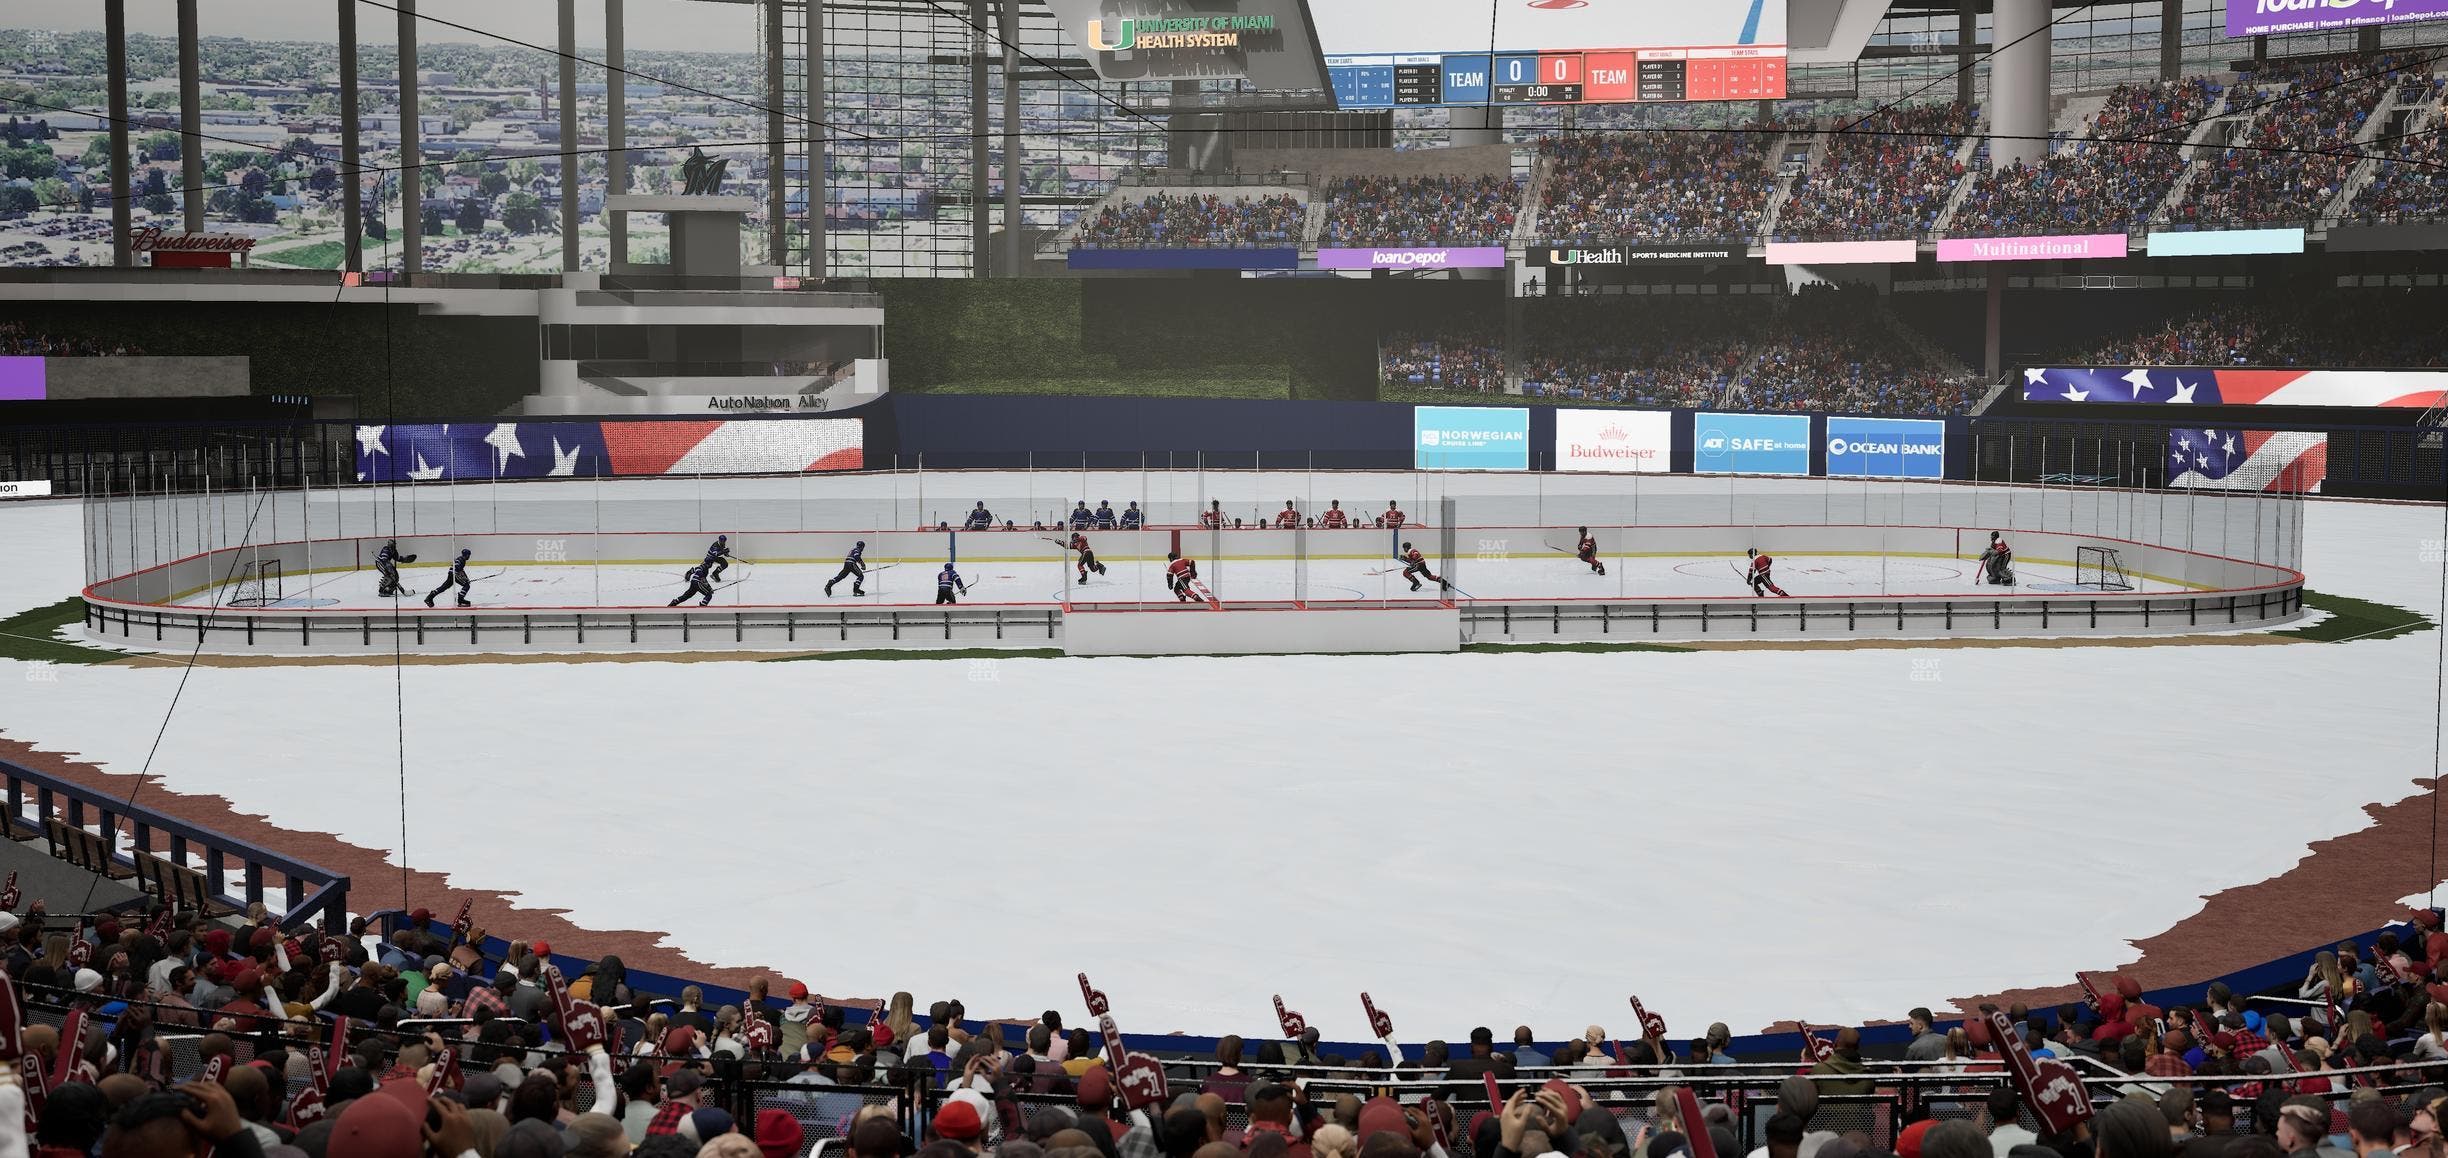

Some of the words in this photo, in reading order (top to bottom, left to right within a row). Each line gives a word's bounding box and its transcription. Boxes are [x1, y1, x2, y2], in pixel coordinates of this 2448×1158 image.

[1135, 17, 1208, 32] UNIVERSITY
[1211, 17, 1230, 30] OF
[1231, 15, 1275, 30] MIAMI
[2246, 25, 2269, 34] HOME
[2270, 21, 2314, 32] PURCHASE
[2320, 20, 2343, 28] Home
[2345, 17, 2385, 26] Refinance
[1136, 34, 1183, 49] HEALTH
[1187, 33, 1237, 47] SYSTEM
[1509, 60, 1521, 82] 0
[1554, 59, 1566, 80] 0
[1590, 69, 1626, 85] TEAM
[1448, 72, 1483, 87] TEAM
[1526, 86, 1548, 97] 0:00
[129, 227, 257, 252] Budweiser
[1973, 239, 2089, 256] Multinational
[1372, 250, 1447, 266] loanDepot
[1631, 252, 1657, 260] SPORTS
[1659, 251, 1691, 259] MEDICINE
[708, 396, 790, 409] AutoNation
[798, 395, 829, 411] Alley
[1441, 430, 1523, 441] NORWEGIAN
[1703, 438, 1725, 449] ADT
[1570, 444, 1656, 459] Budweiser
[1731, 438, 1774, 451] SAFE
[1774, 441, 1782, 449] at
[1784, 440, 1807, 449] home
[1849, 442, 1898, 454] OCEAN
[1901, 444, 1941, 455] BANK
